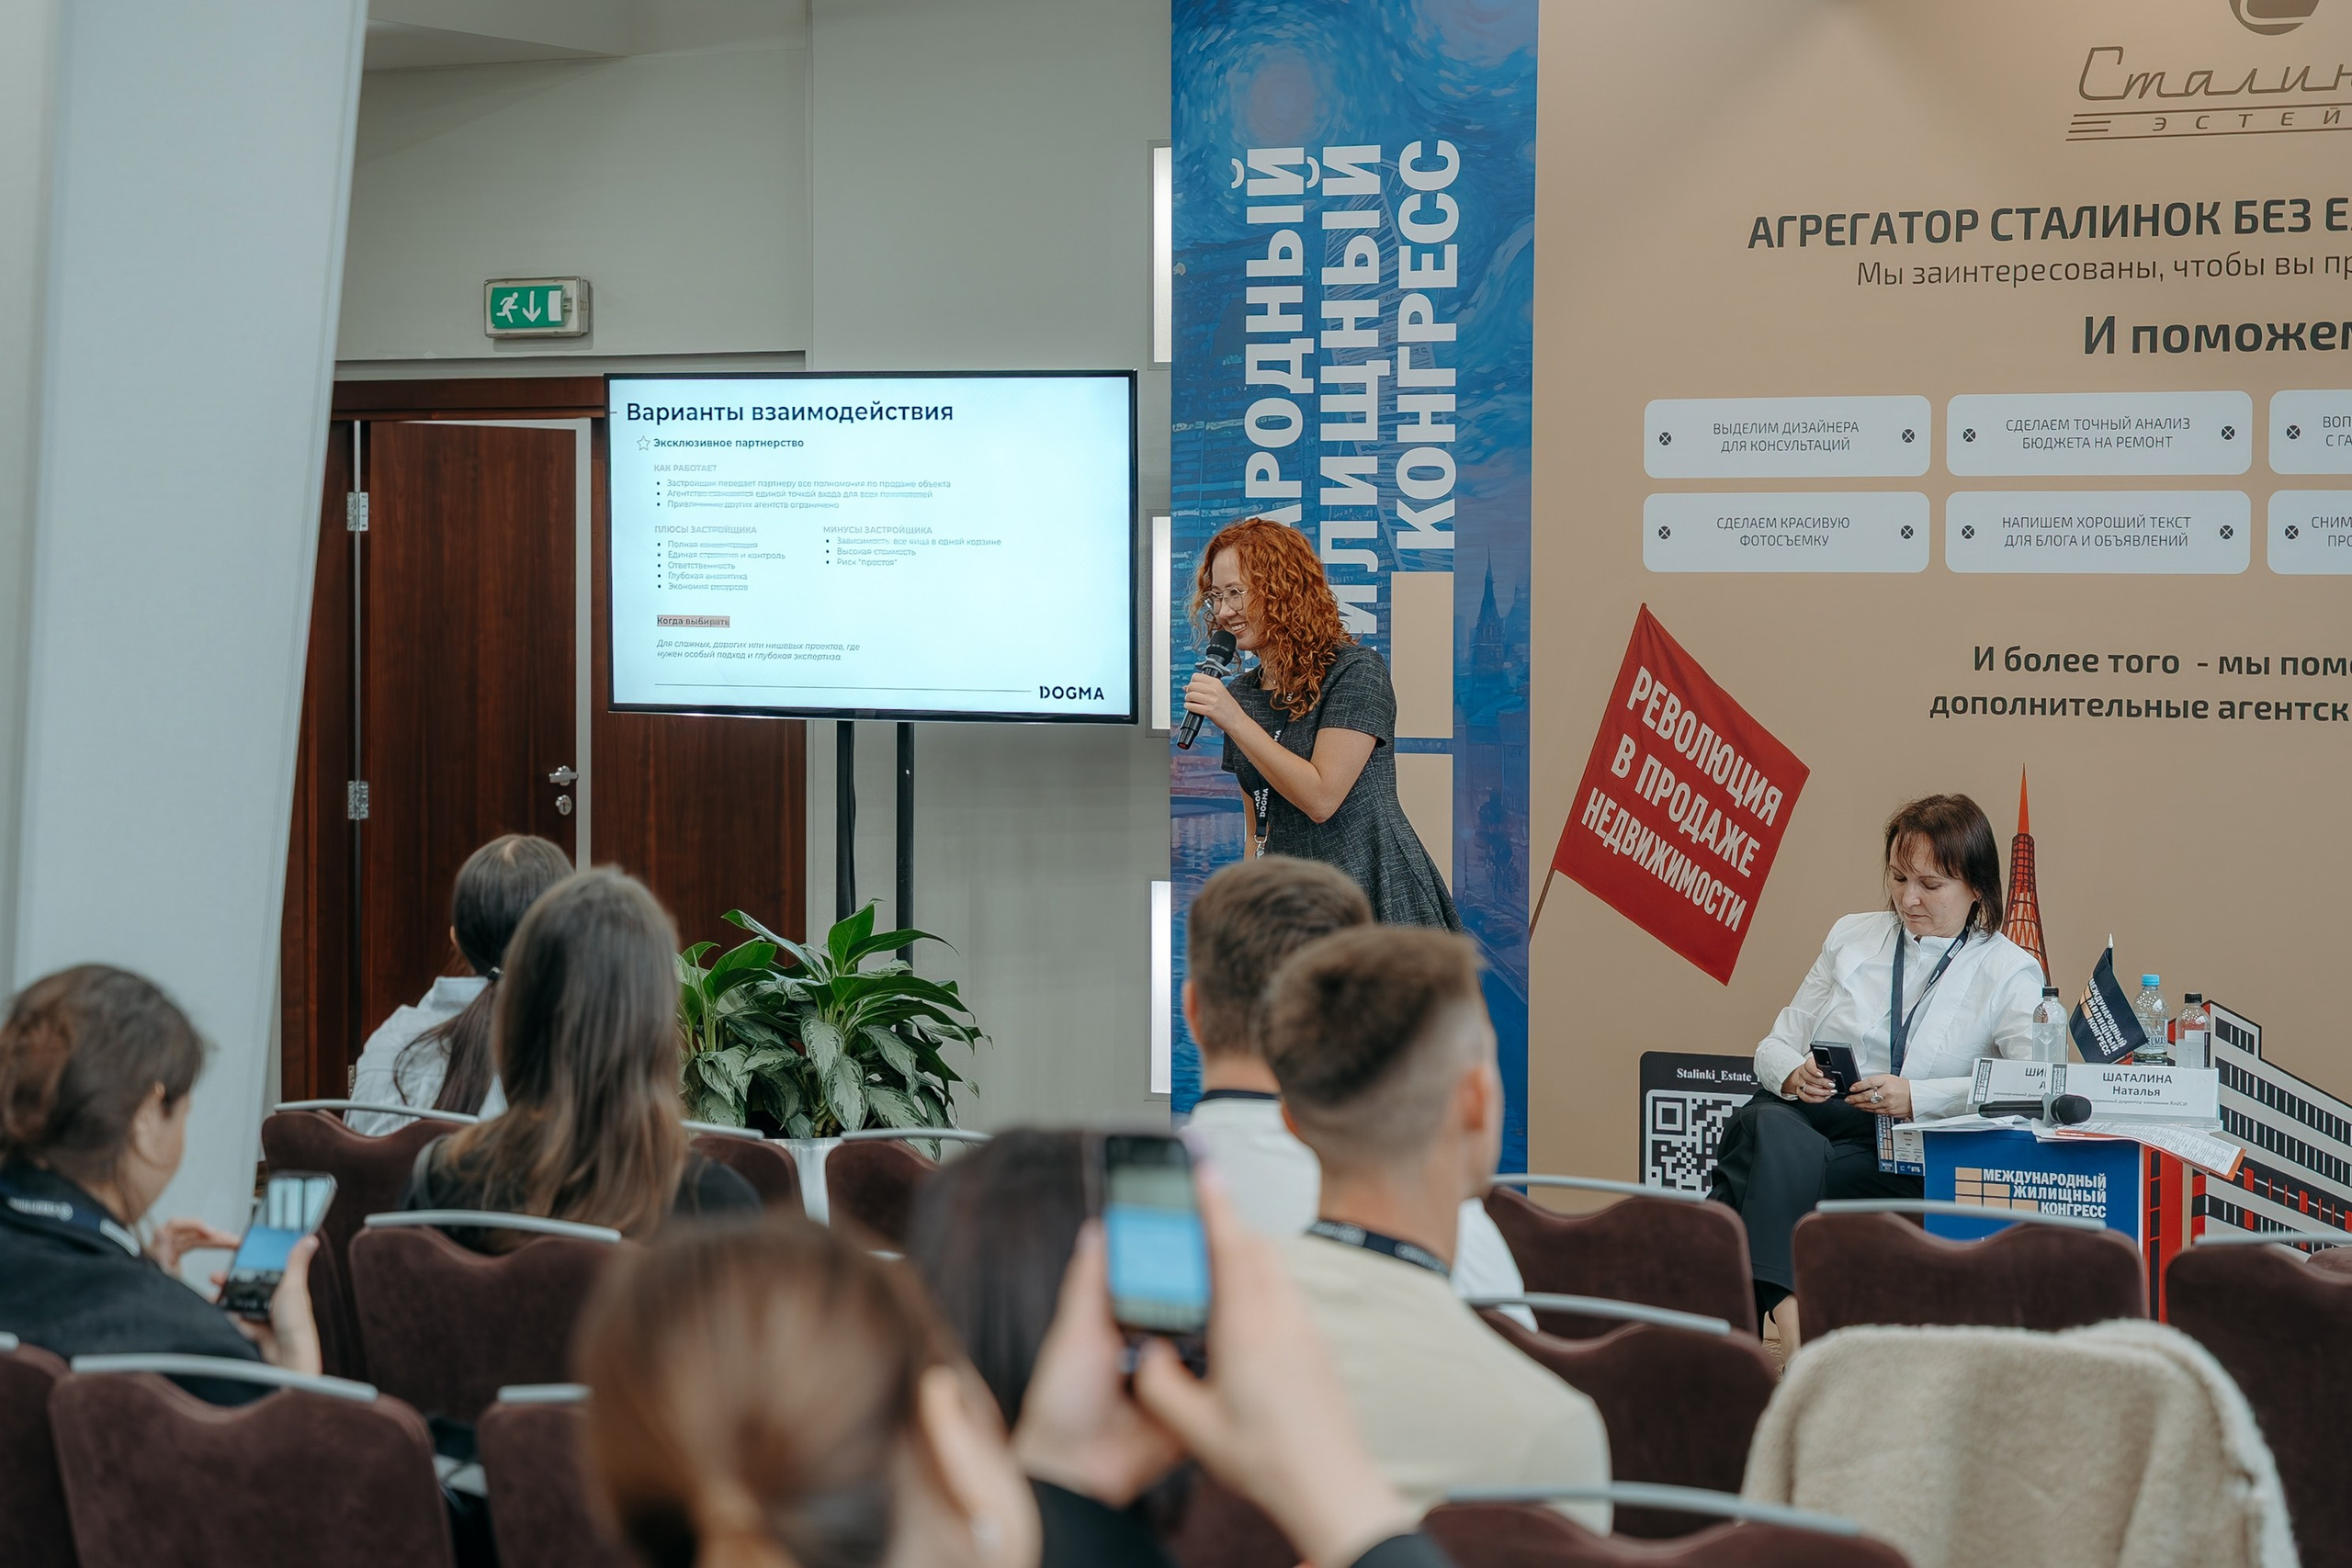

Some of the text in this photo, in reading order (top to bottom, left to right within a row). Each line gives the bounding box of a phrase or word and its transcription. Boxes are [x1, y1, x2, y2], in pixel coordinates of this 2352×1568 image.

[1747, 196, 2352, 249] АГРЕГАТОР СТАЛИНОК БЕЗ Е
[1857, 261, 1904, 287] Мы
[1912, 256, 2165, 288] заинтересованы,
[2173, 250, 2265, 278] чтобы
[2276, 256, 2314, 276] вы
[2084, 315, 2115, 355] И
[1395, 139, 1462, 550] КОНГРЕСС
[1306, 144, 1390, 636] ИЛИЩНЫЙ
[627, 400, 954, 426] Варианты взаимодействия
[1713, 419, 1860, 435] ВЫДЕЛИМ ДИЗАЙНЕРА
[2006, 415, 2190, 434] СДЕЛАЕМ ТОЧНЫЙ АНАЛИЗ
[653, 438, 805, 449] Эксклюзивное партнерство
[1720, 436, 1850, 454] ДЛЯ КОНСУЛЬТАЦИЙ
[2022, 435, 2173, 450] БЮДЖЕТА НА РЕМОНТ
[2325, 434, 2334, 446] С
[653, 464, 718, 472] КАК РАБОТАЕТ
[757, 480, 797, 489] партнеру
[822, 525, 933, 535] МИНУСЫ ЗАСТРОЙЩИКА
[1716, 516, 1850, 531] СДЕЛАЕМ КРАСИВУЮ
[2002, 513, 2191, 529] НАПИШЕМ ХОРОШИЙ ТЕКСТ
[1739, 534, 1829, 547] ФОТОСЪЕМКУ
[2004, 532, 2188, 548] ДЛЯ БЛОГА И ОБЪЯВЛЕНИЙ
[657, 616, 684, 626] Когда
[1973, 646, 1995, 672] И
[2004, 645, 2099, 673] более
[2108, 653, 2180, 674] того
[2219, 655, 2270, 675] мы
[2281, 656, 2352, 677] пом
[1039, 685, 1105, 701] DOGMA
[1929, 695, 2350, 722] дополнительные агентск
[1626, 665, 1784, 827] РЕВОЛЮЦИЯ
[1259, 787, 1269, 818] DOGMA
[1611, 733, 1761, 878] В ПРОДАЖЕ
[1580, 786, 1747, 933] НЕДВИЖИМОСТИ
[2086, 997, 2120, 1053] ЖИЛИЩНЫЙ
[2086, 1017, 2111, 1056] КОНГРЕСС
[2102, 1072, 2173, 1085] ШАТАЛИНА
[2112, 1085, 2161, 1097] Наталья
[1983, 1168, 2107, 1189] МЕЖДУНАРОДНЫЙ
[2013, 1185, 2107, 1203] ЖИЛИЩНЫЙ
[2041, 1201, 2107, 1219] КОНГРЕСС
